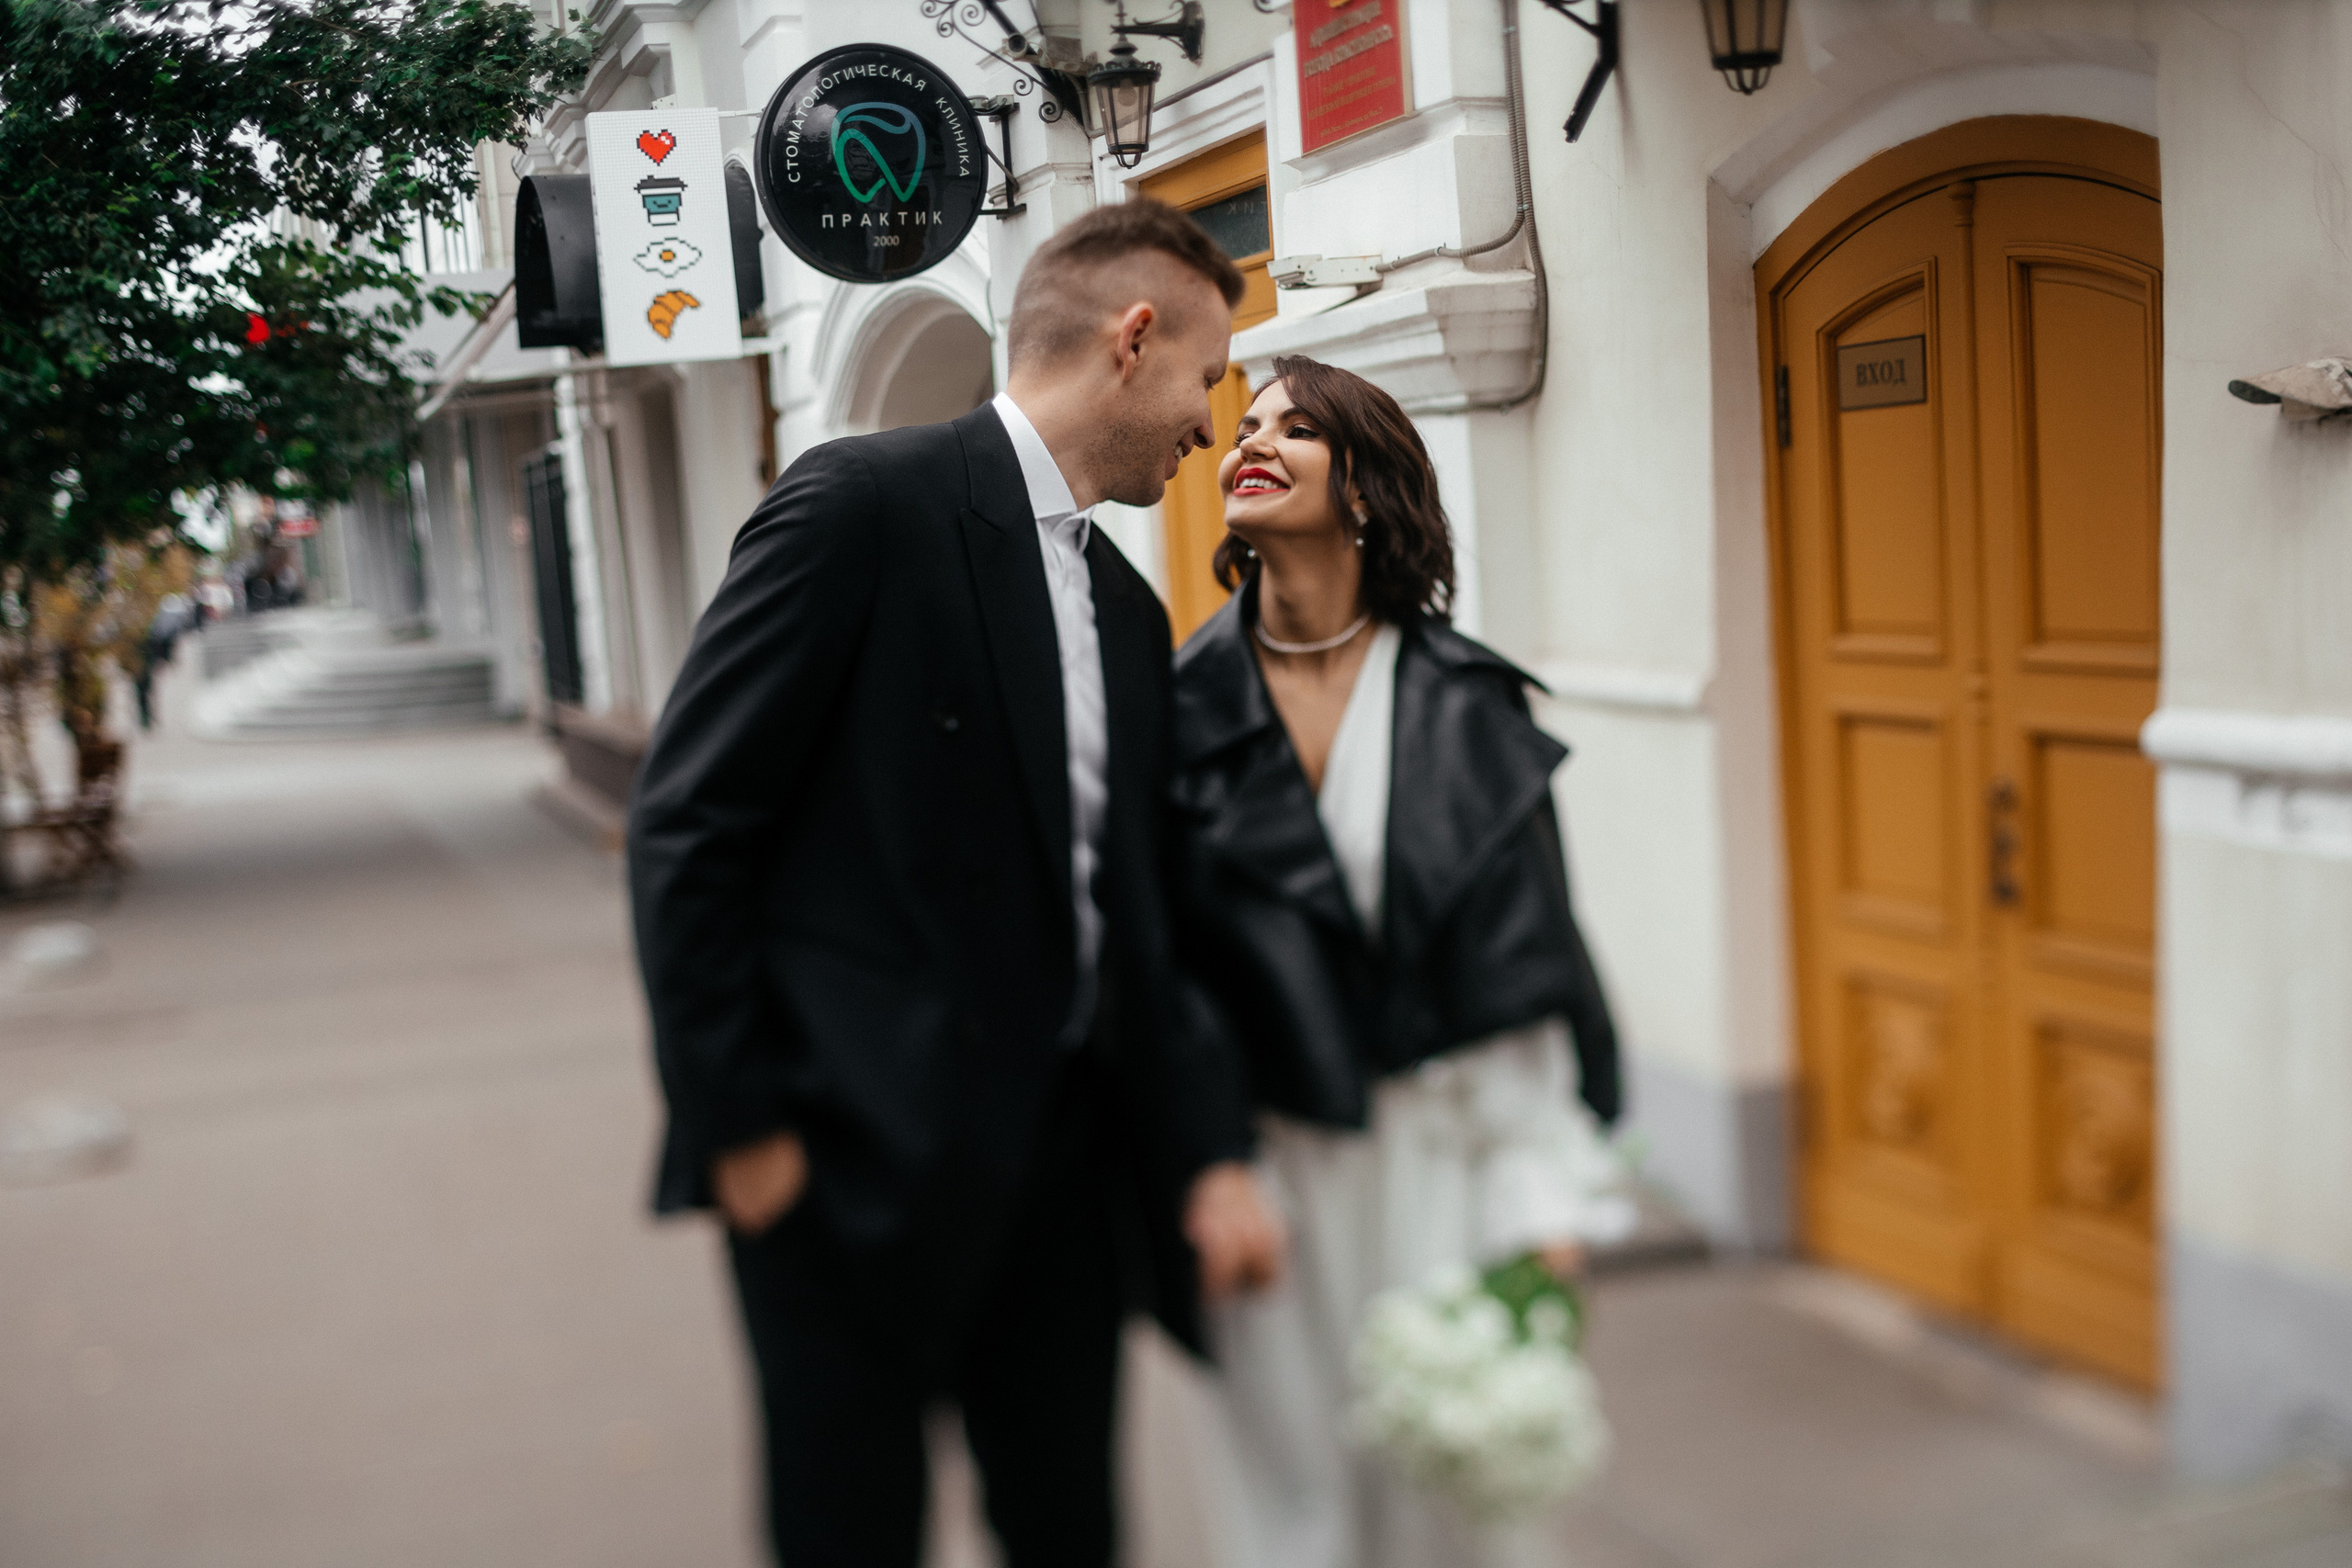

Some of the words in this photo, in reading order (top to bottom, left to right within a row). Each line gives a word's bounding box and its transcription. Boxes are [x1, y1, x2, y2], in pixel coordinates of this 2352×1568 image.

[786, 64, 927, 183] СТОМАТОЛОГИЧЕСКАЯ
[935, 96, 970, 176] КЛИНИКА
[821, 210, 943, 229] ПРАКТИК
[873, 235, 900, 247] 2000
[1856, 357, 1906, 387] ВХОД
